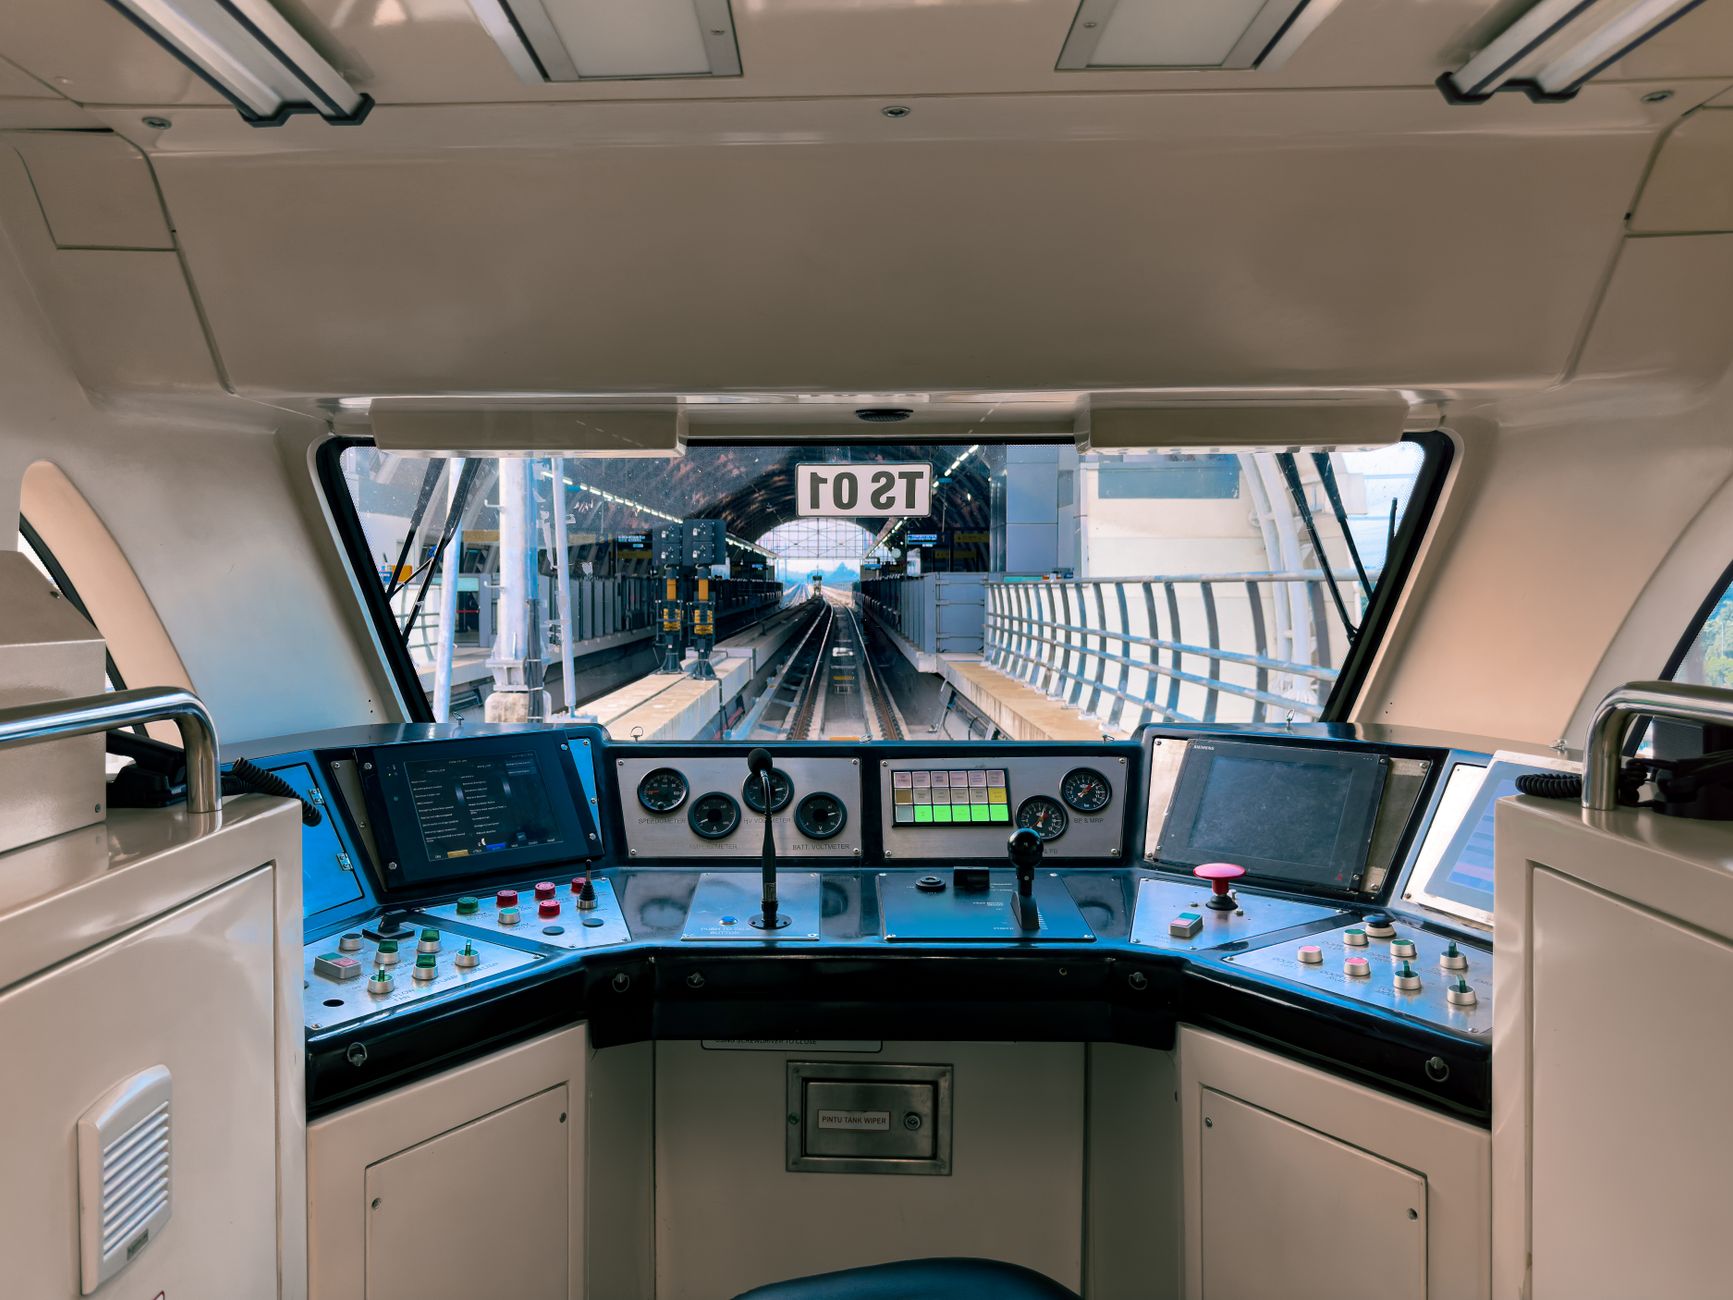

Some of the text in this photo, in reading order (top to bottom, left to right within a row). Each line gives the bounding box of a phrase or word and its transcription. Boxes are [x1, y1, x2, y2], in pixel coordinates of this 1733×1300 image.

[822, 1115, 887, 1125] PINTU TANK WIPER
